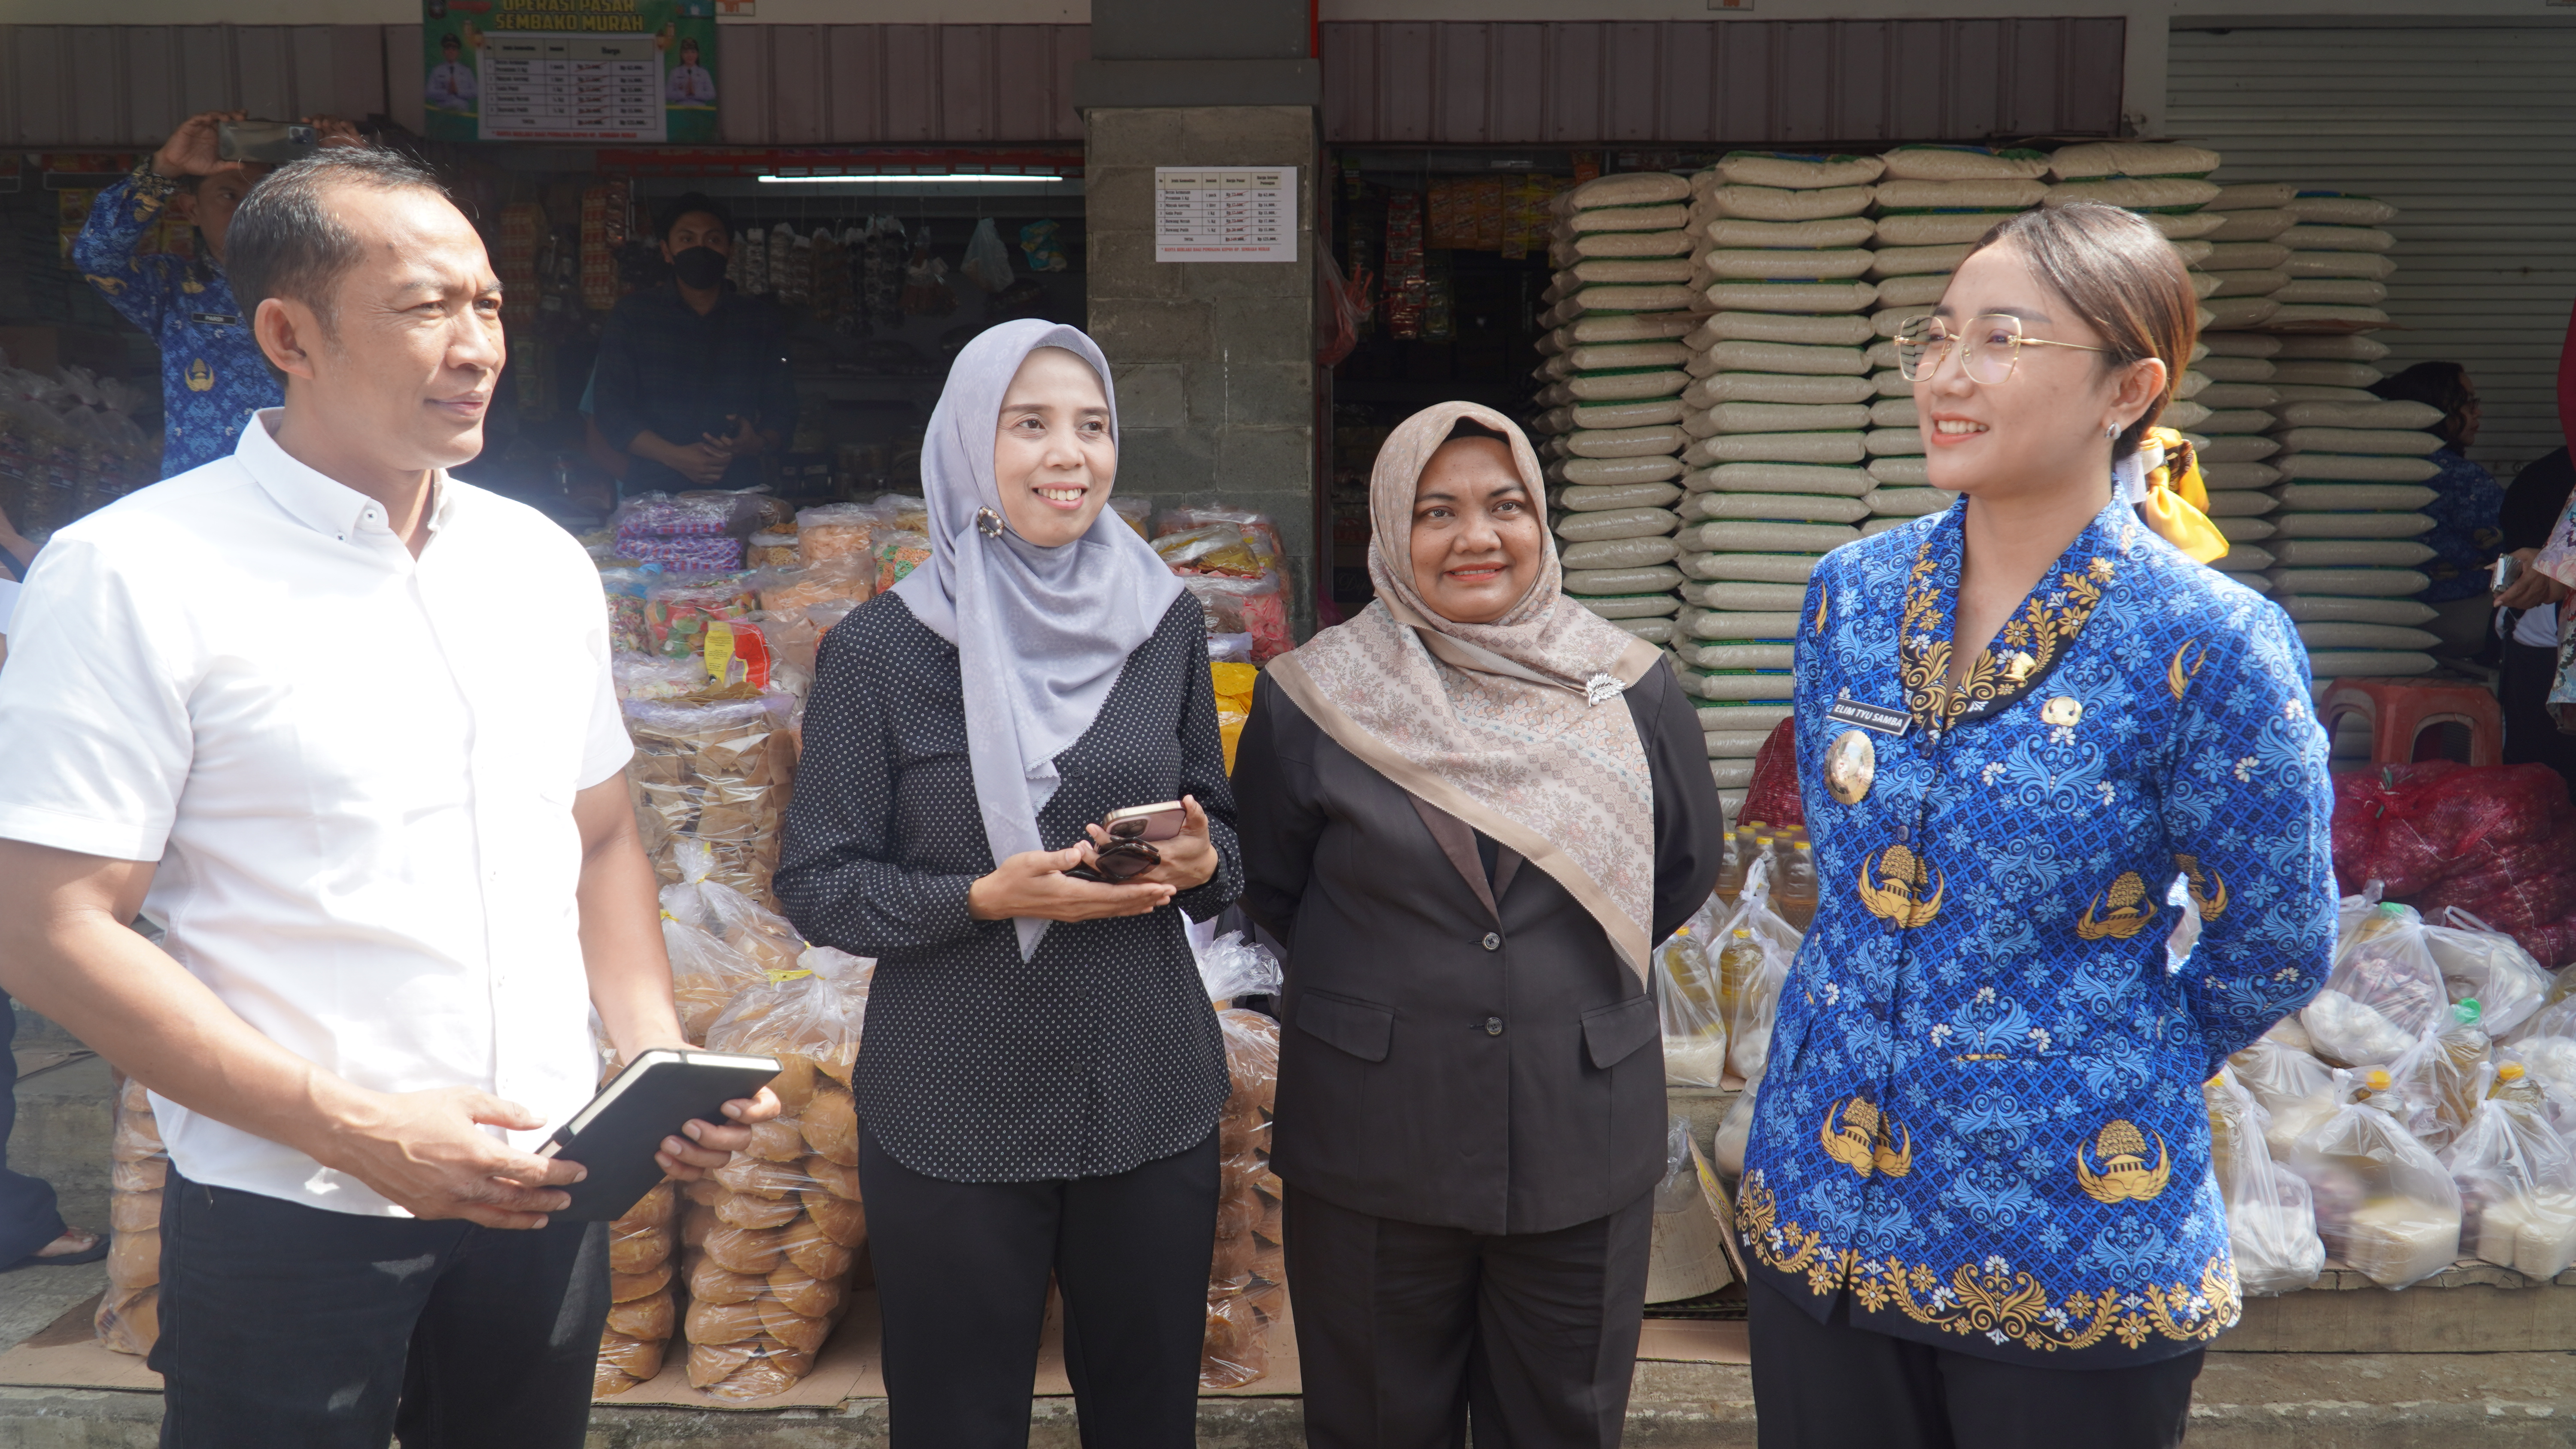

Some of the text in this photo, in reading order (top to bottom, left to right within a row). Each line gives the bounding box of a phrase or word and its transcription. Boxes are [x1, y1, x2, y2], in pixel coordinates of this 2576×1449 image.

[502, 0, 636, 12] OPERASI PASAR
[496, 13, 644, 30] SEMBAKO MURAH
[1834, 704, 1903, 728] ELIM TYU SAMBA
